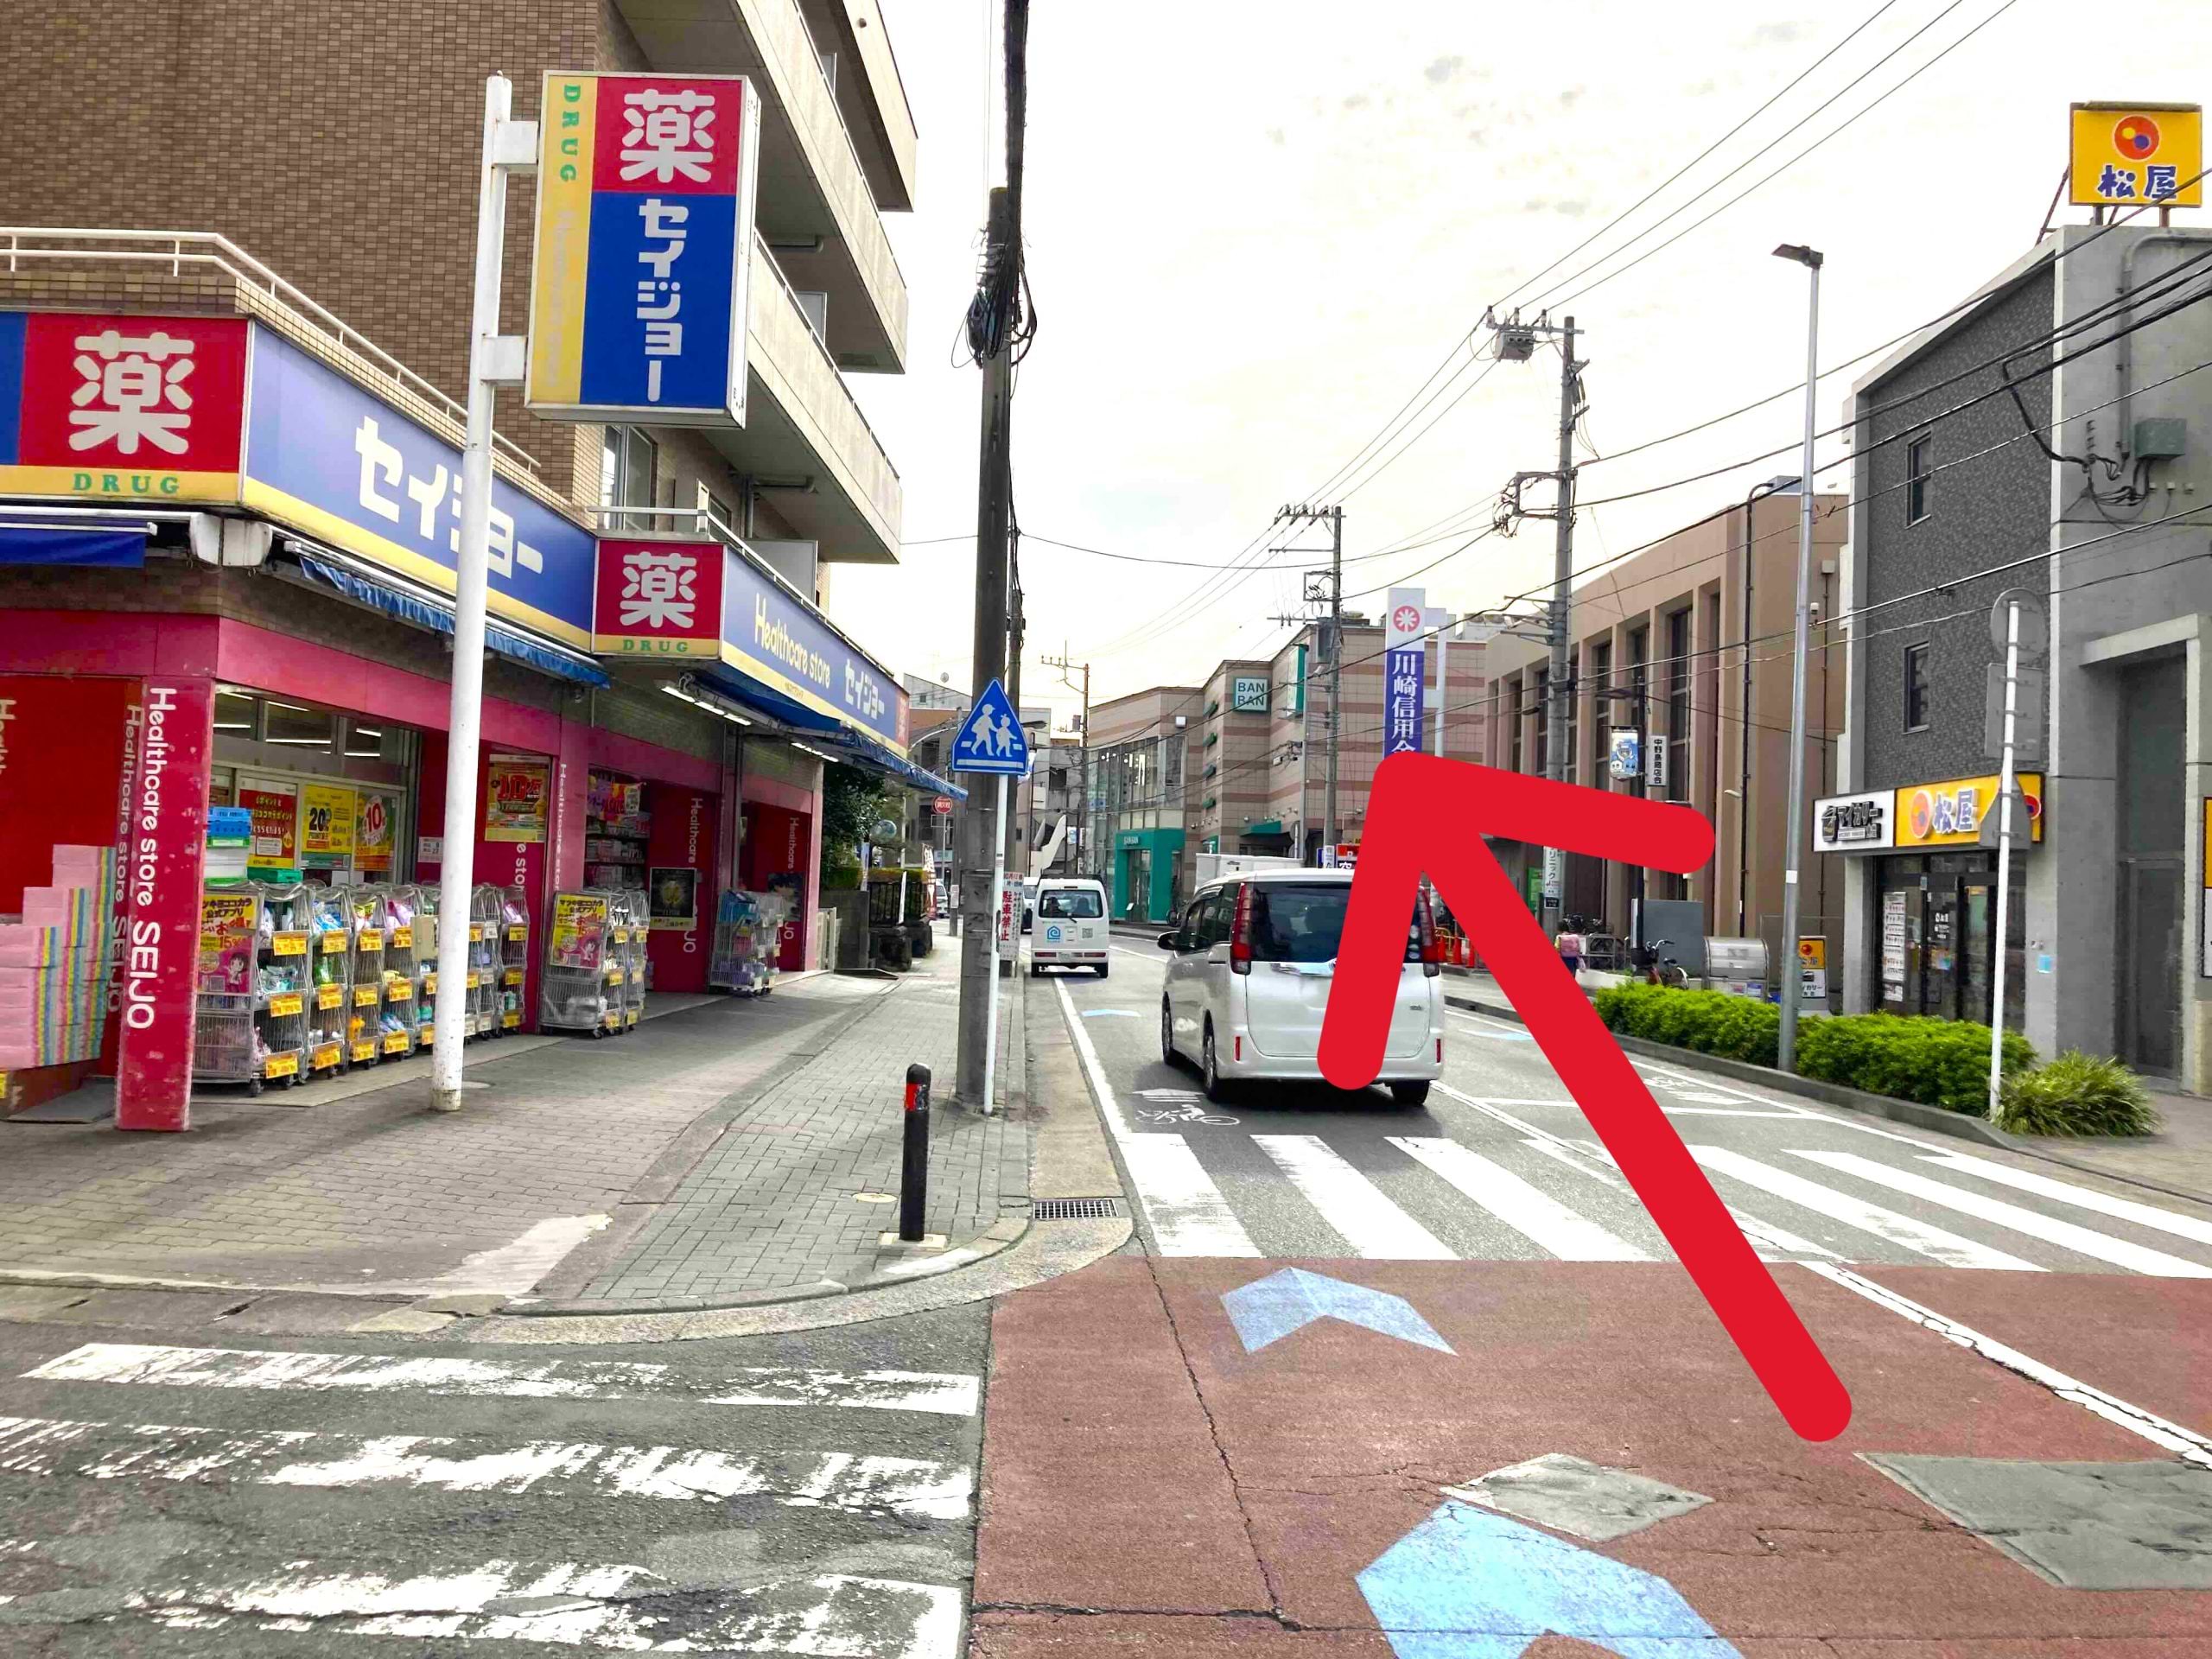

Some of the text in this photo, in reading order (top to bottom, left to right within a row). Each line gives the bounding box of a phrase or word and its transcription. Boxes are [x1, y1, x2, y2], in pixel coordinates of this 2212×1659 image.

[560, 84, 581, 182] DRUG
[620, 88, 715, 183] 薬
[2097, 164, 2177, 199] 松屋
[637, 198, 690, 403] セイジョー
[68, 330, 195, 455] 薬
[73, 473, 181, 495] DRUG
[620, 551, 697, 629] 薬
[622, 639, 690, 653] DRUG
[754, 593, 808, 676] Healthcare
[809, 651, 830, 690] store
[1236, 695, 1264, 706] BAN
[1237, 682, 1265, 693] BAN
[1391, 653, 1418, 753] 川崎信用金
[118, 704, 144, 835] Healthcare
[688, 797, 704, 864] Healthcare
[1931, 788, 1980, 835] 松屋
[115, 841, 129, 903] store
[126, 687, 177, 1029] Healthcare store SEIJO
[515, 858, 527, 892] stor
[1548, 850, 1557, 880] リニック
[1001, 890, 1013, 942] 駐車禁止
